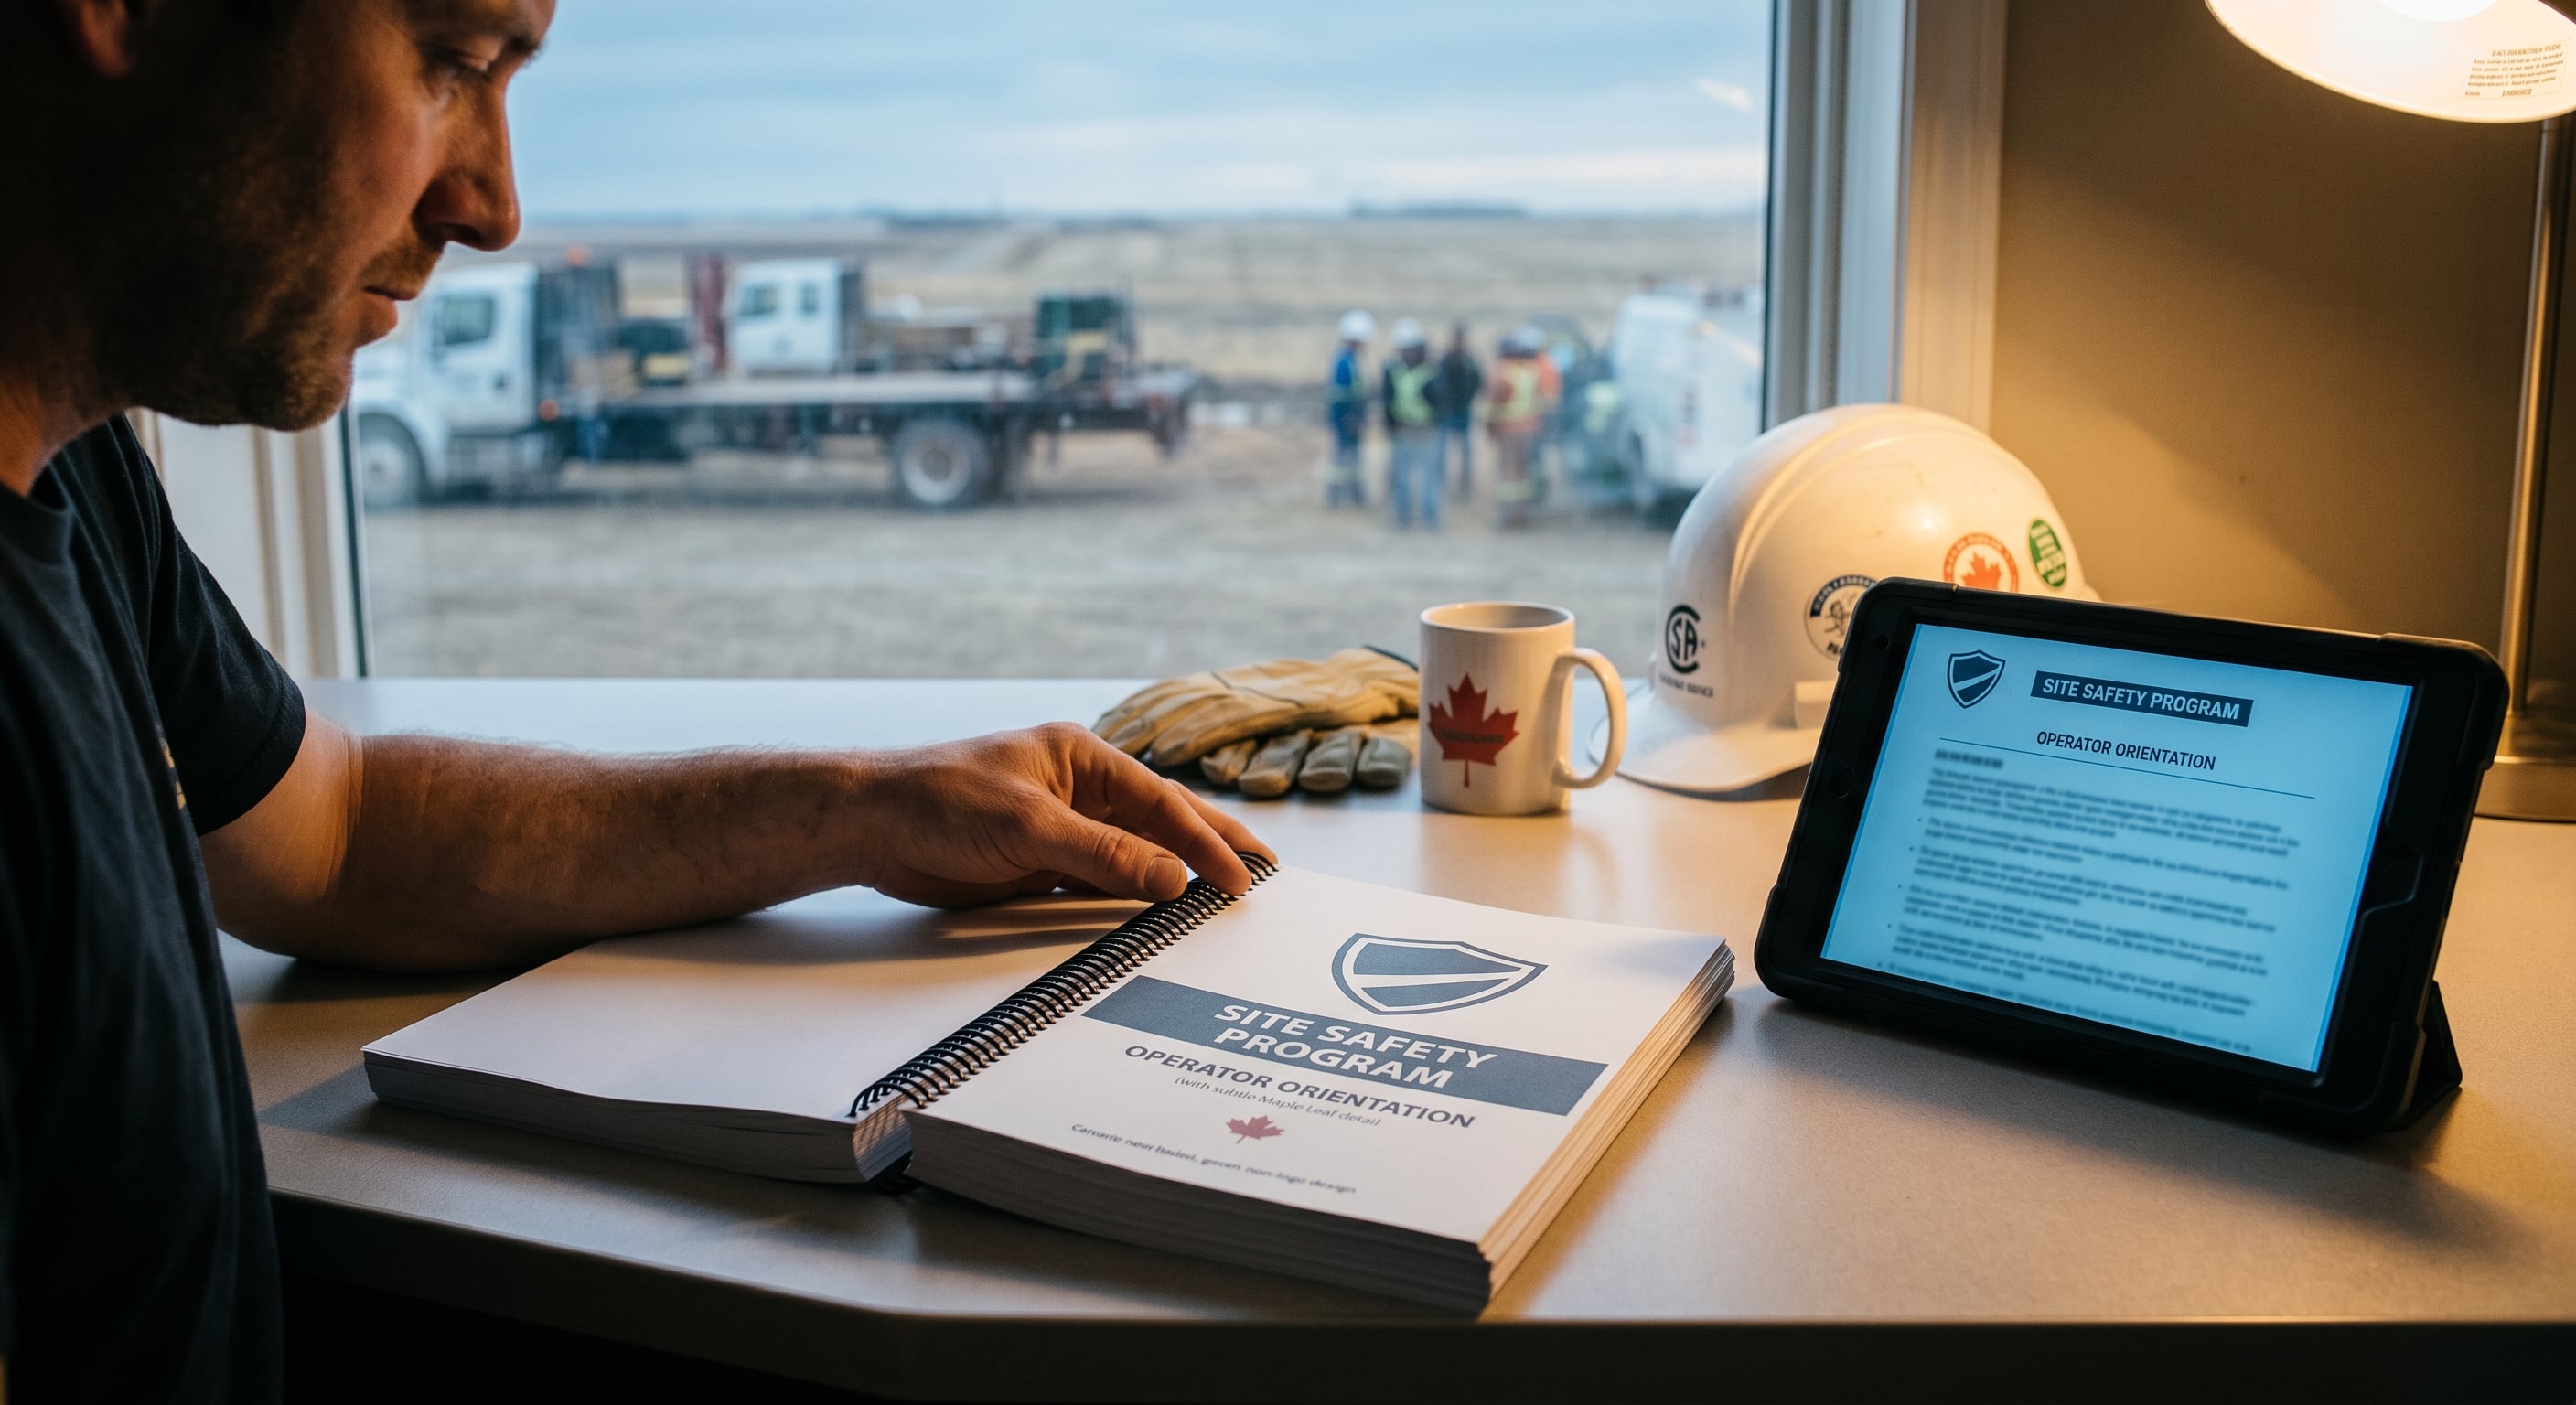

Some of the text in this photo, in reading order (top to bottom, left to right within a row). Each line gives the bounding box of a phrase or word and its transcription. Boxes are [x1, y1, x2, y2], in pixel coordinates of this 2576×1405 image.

[2043, 678, 2240, 720] SITE SAFETY PROGRAM
[2036, 731, 2216, 770] OPERATOR ORIENTATION
[1214, 1004, 1498, 1069] SITE SAFETY
[1214, 1027, 1454, 1089] PROGRAM
[1125, 1046, 1476, 1128] OPERATOR ORIENTATION
[1175, 1077, 1210, 1091] (with
[1212, 1086, 1257, 1100] subtle
[1258, 1095, 1304, 1110] Maple
[1305, 1104, 1338, 1118] Leaf
